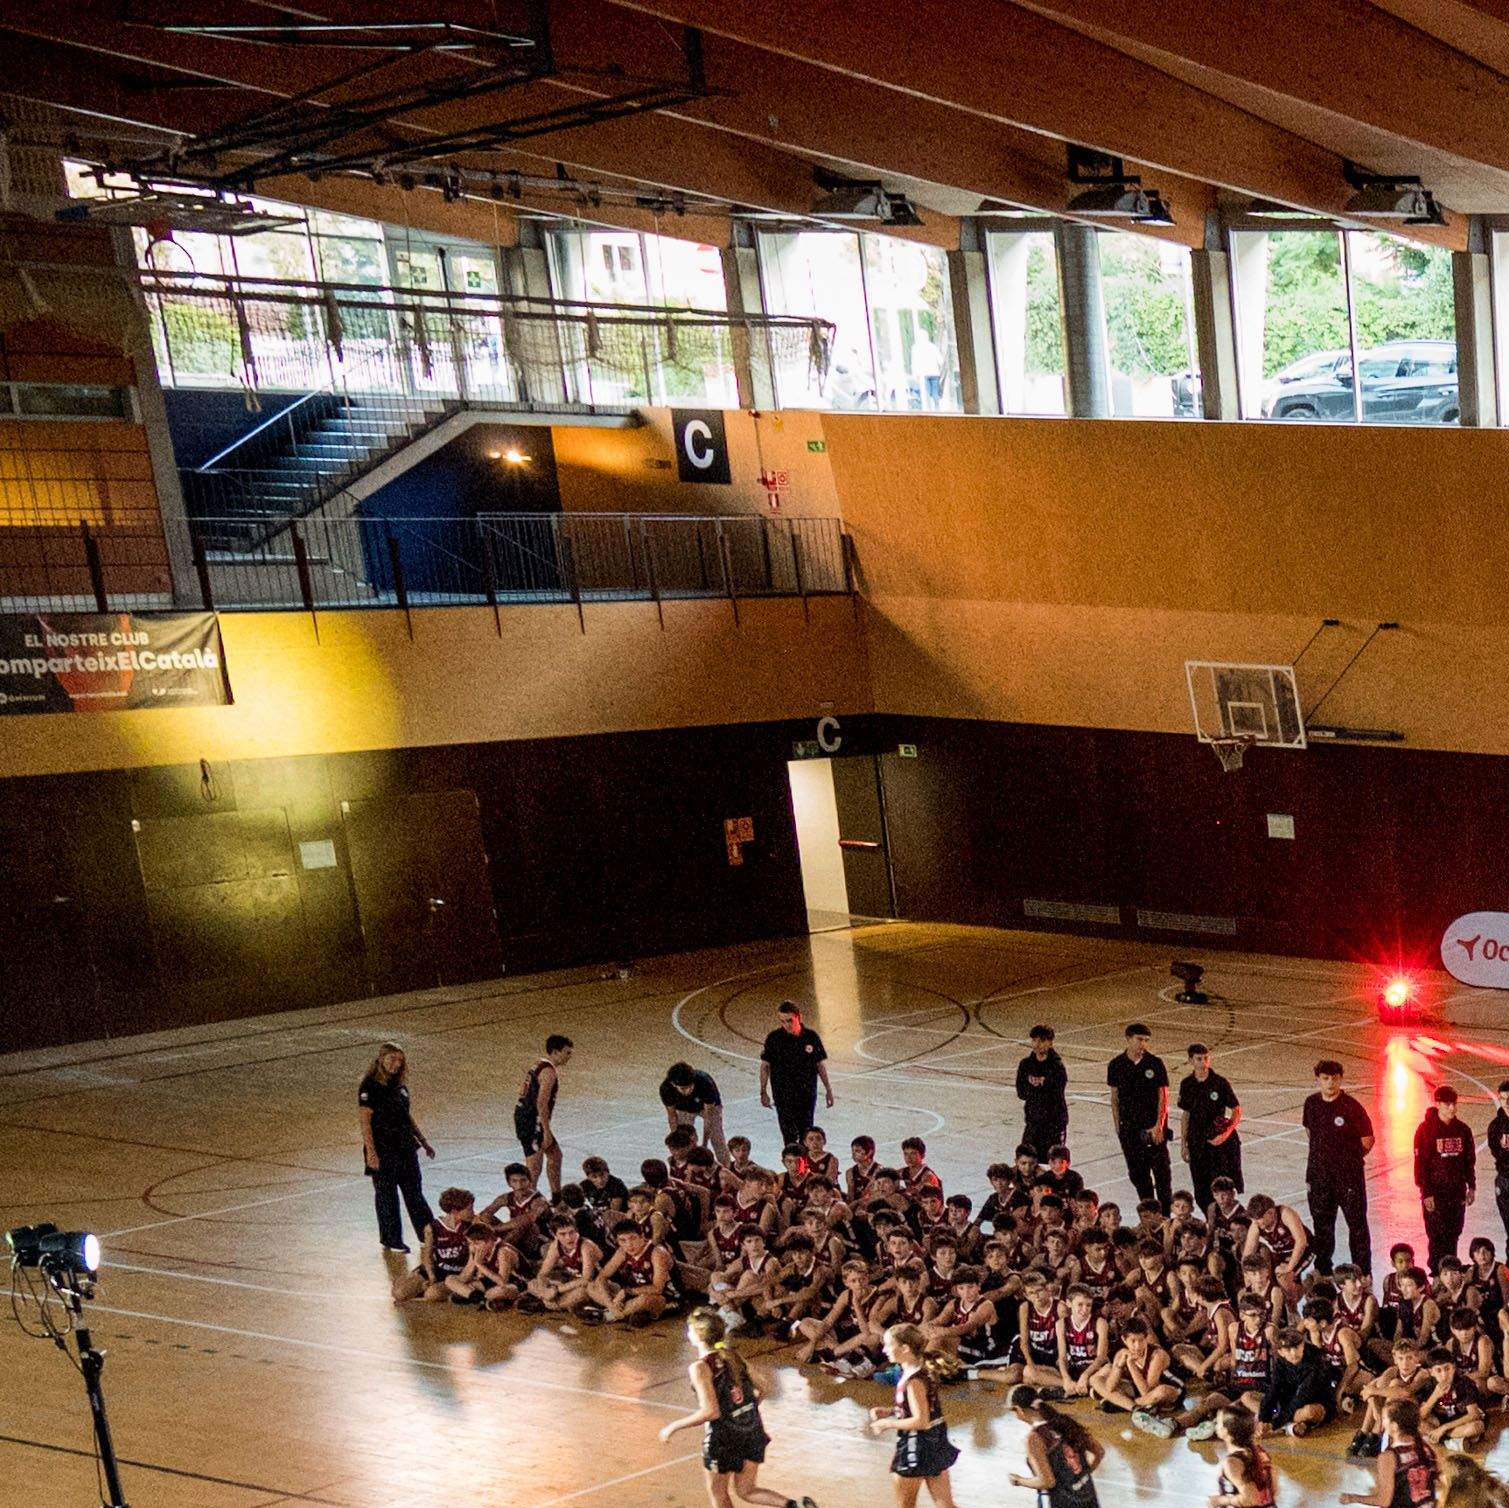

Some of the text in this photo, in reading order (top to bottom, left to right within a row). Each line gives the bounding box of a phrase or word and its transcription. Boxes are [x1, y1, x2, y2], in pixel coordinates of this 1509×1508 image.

[684, 419, 714, 469] C
[25, 631, 150, 648] EL NOSTRE CLUB
[817, 717, 842, 752] C
